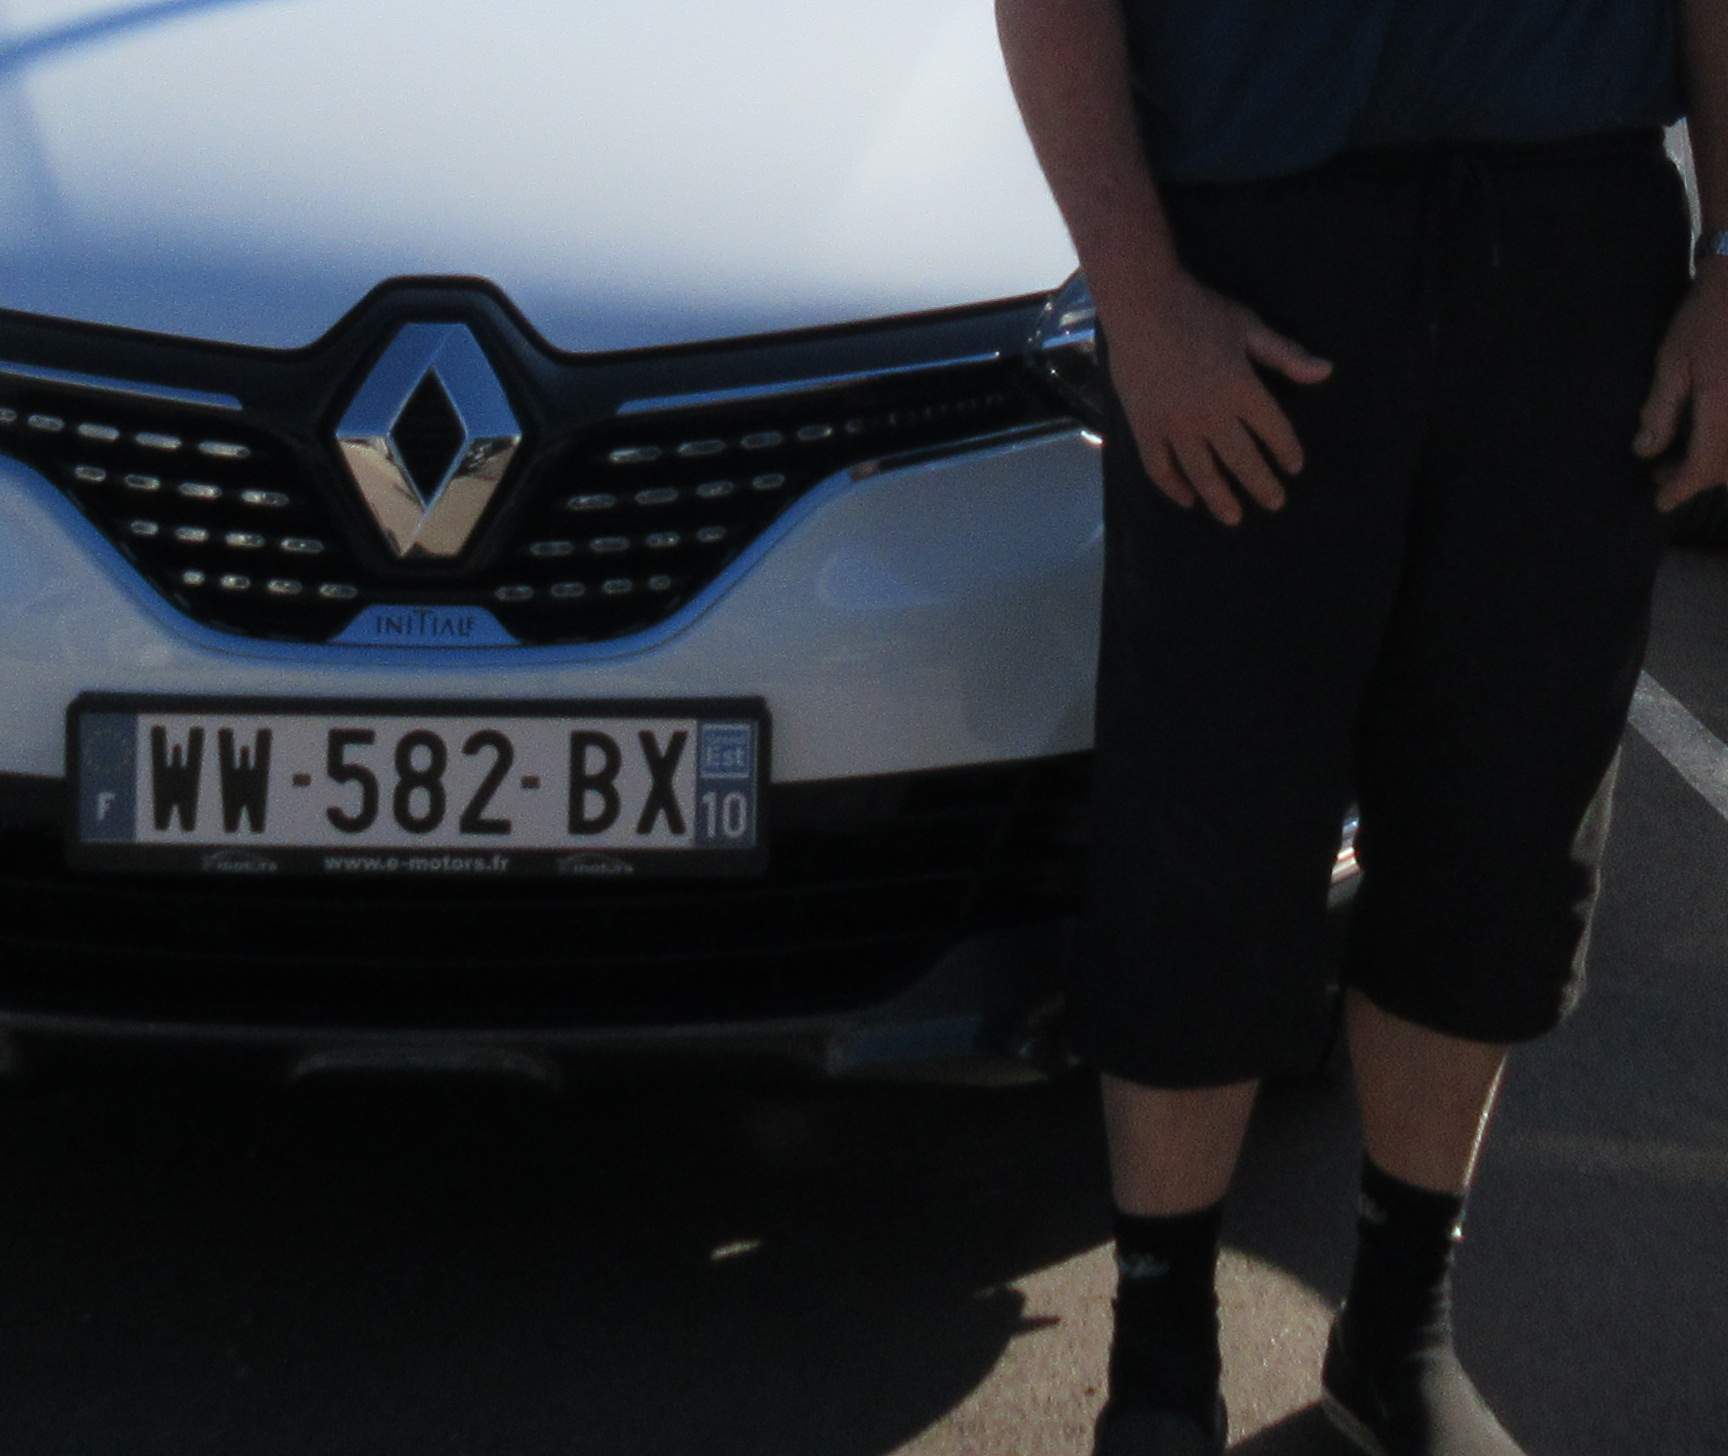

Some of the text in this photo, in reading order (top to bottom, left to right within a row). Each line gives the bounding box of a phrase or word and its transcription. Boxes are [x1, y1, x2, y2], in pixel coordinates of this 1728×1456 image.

[96, 792, 116, 821] F
[701, 791, 747, 838] 10
[324, 854, 510, 874] www.e-motors.fr
